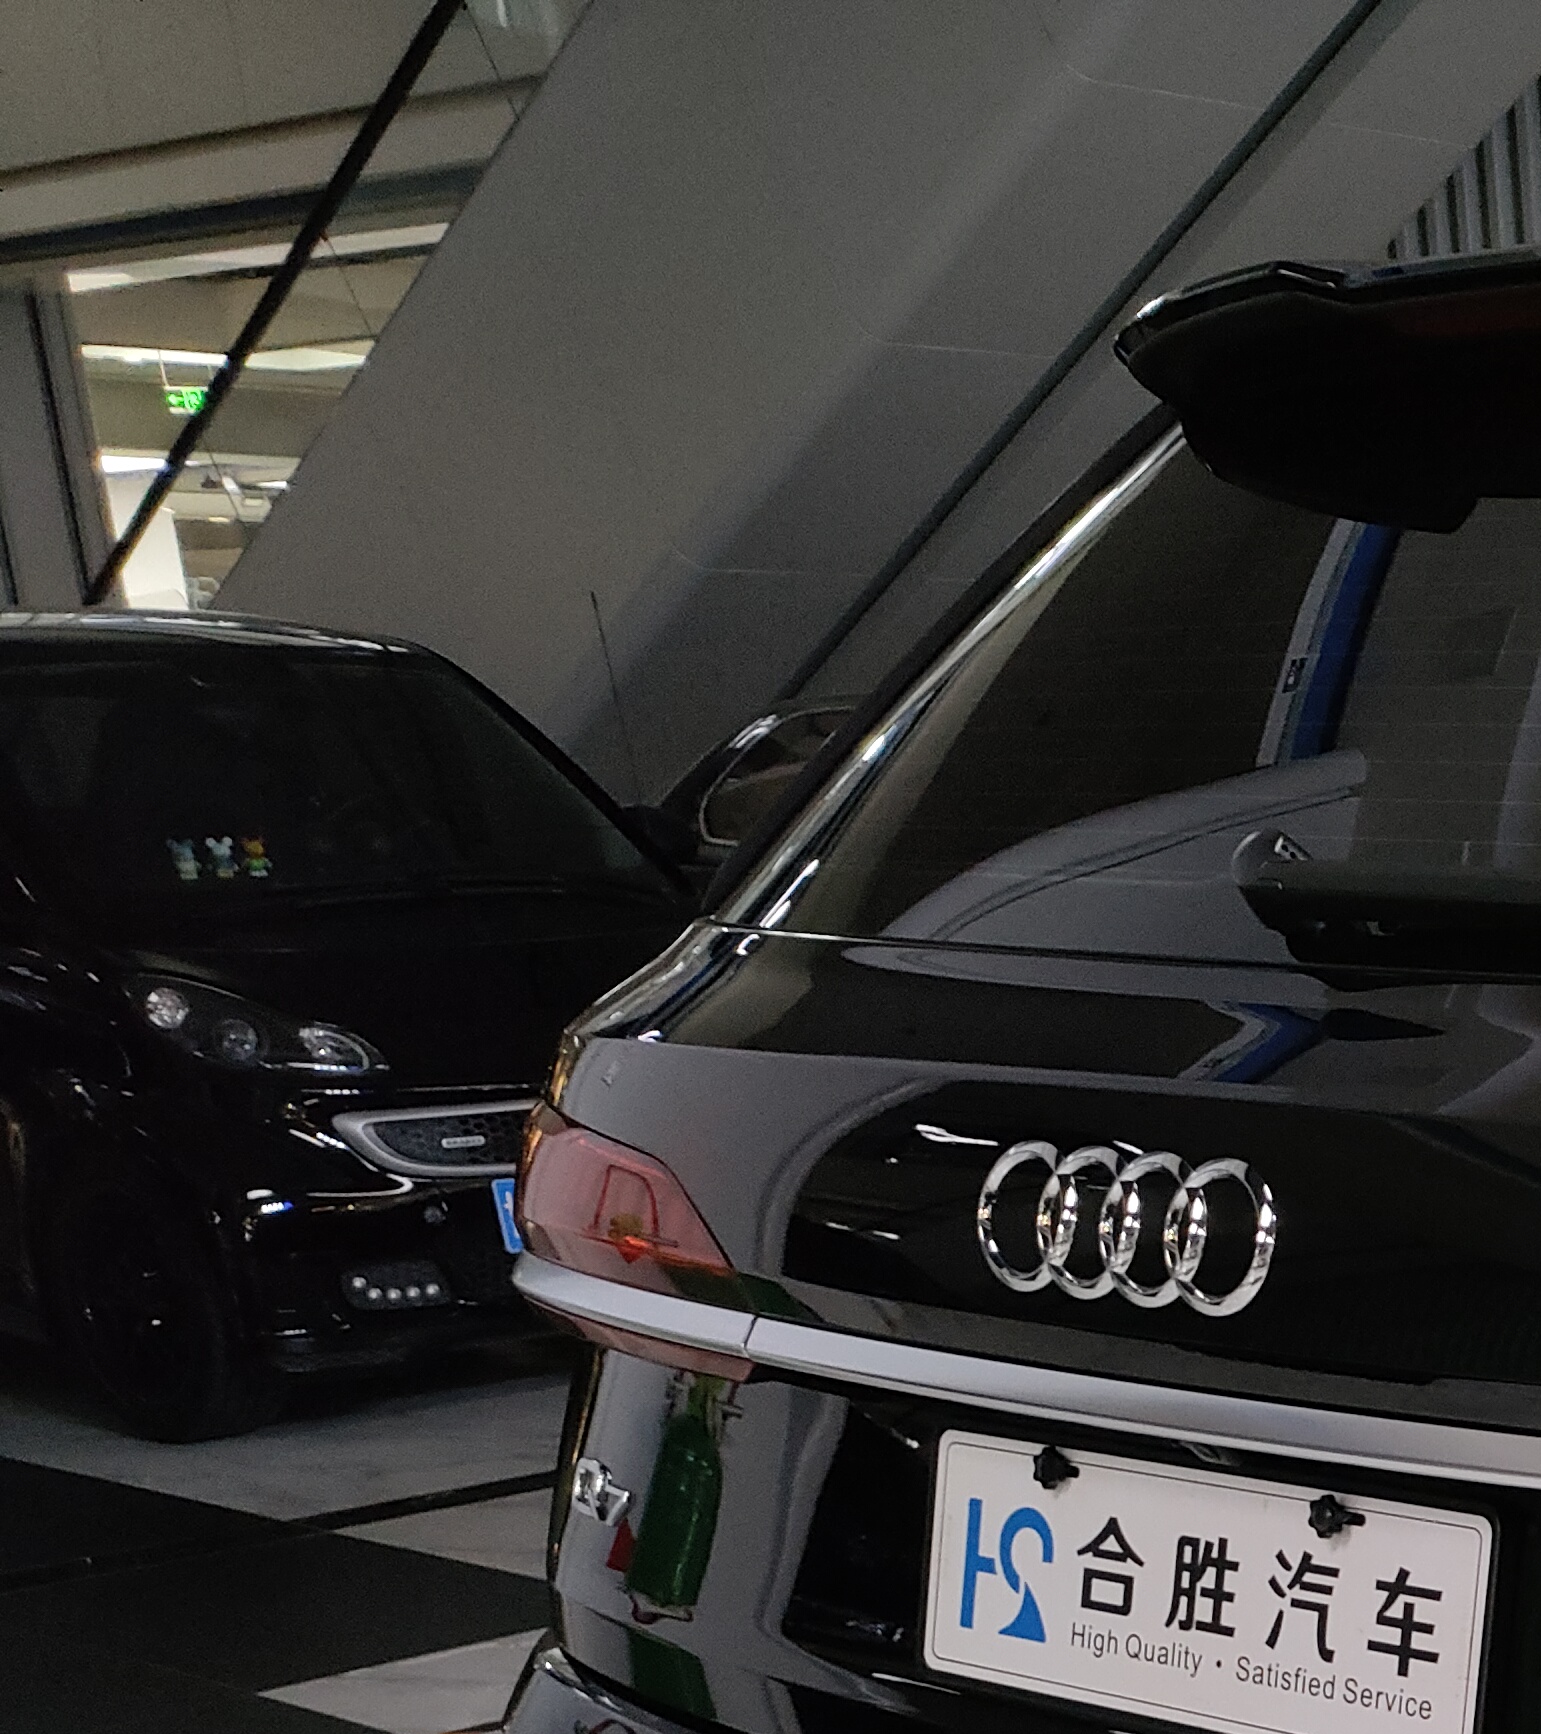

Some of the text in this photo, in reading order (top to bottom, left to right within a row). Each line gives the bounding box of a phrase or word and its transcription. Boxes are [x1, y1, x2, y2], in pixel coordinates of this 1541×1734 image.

[1076, 1516, 1443, 1678] 合胜汽车
[1070, 1621, 1433, 1720] High Quality Satisfied Service
